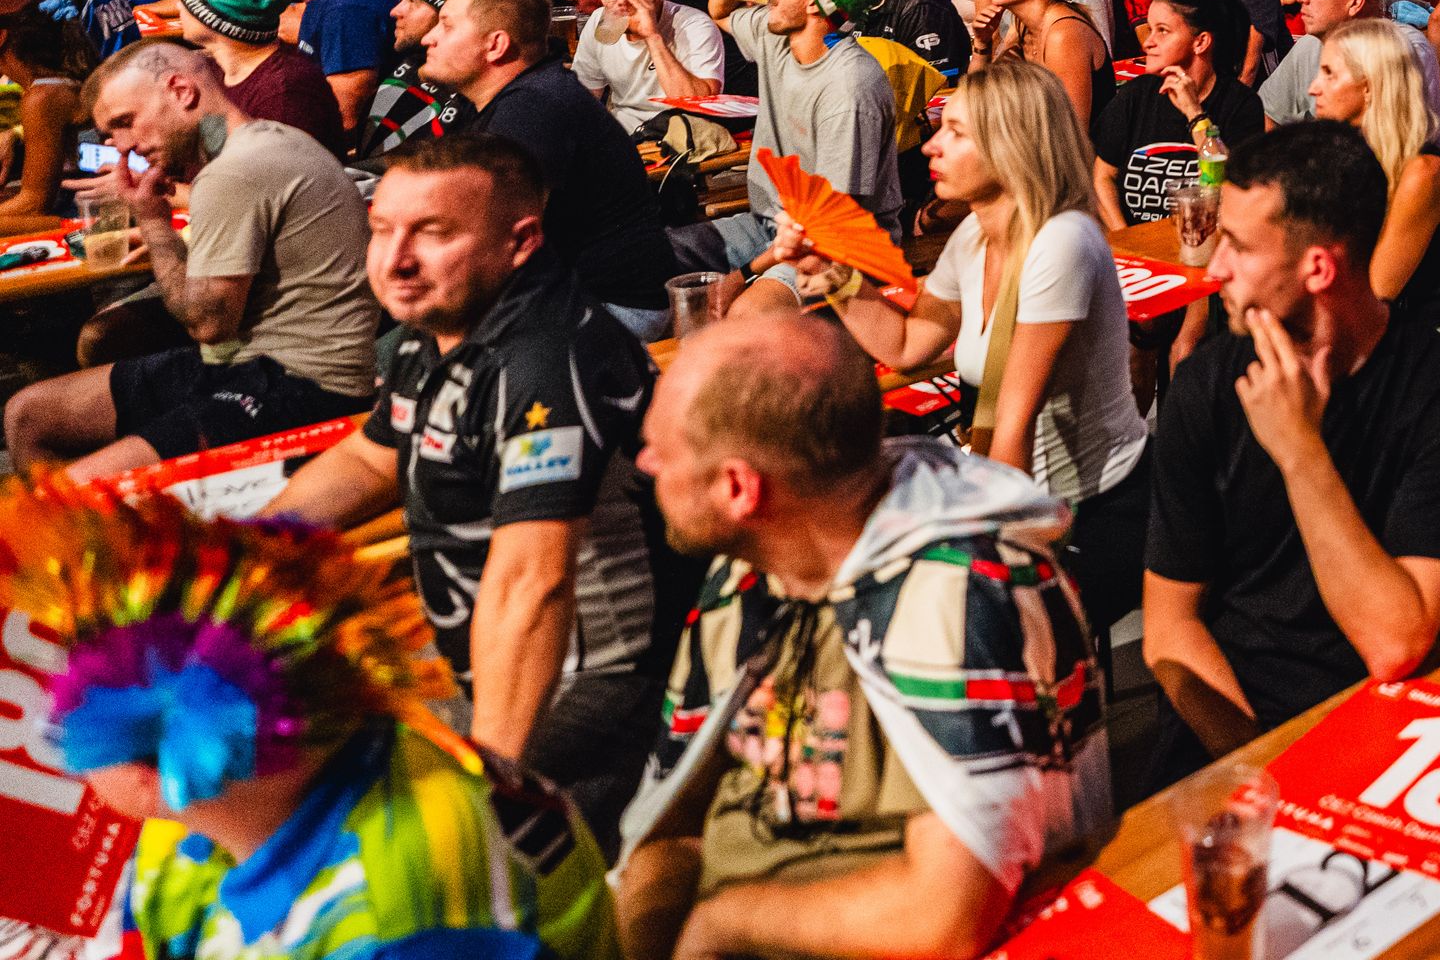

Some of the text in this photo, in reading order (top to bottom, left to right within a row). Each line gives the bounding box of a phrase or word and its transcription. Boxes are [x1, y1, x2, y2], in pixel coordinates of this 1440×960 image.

[393, 63, 411, 78] 5
[1127, 154, 1201, 177] CZEC
[1125, 192, 1178, 211] OPE
[1112, 264, 1187, 302] 80
